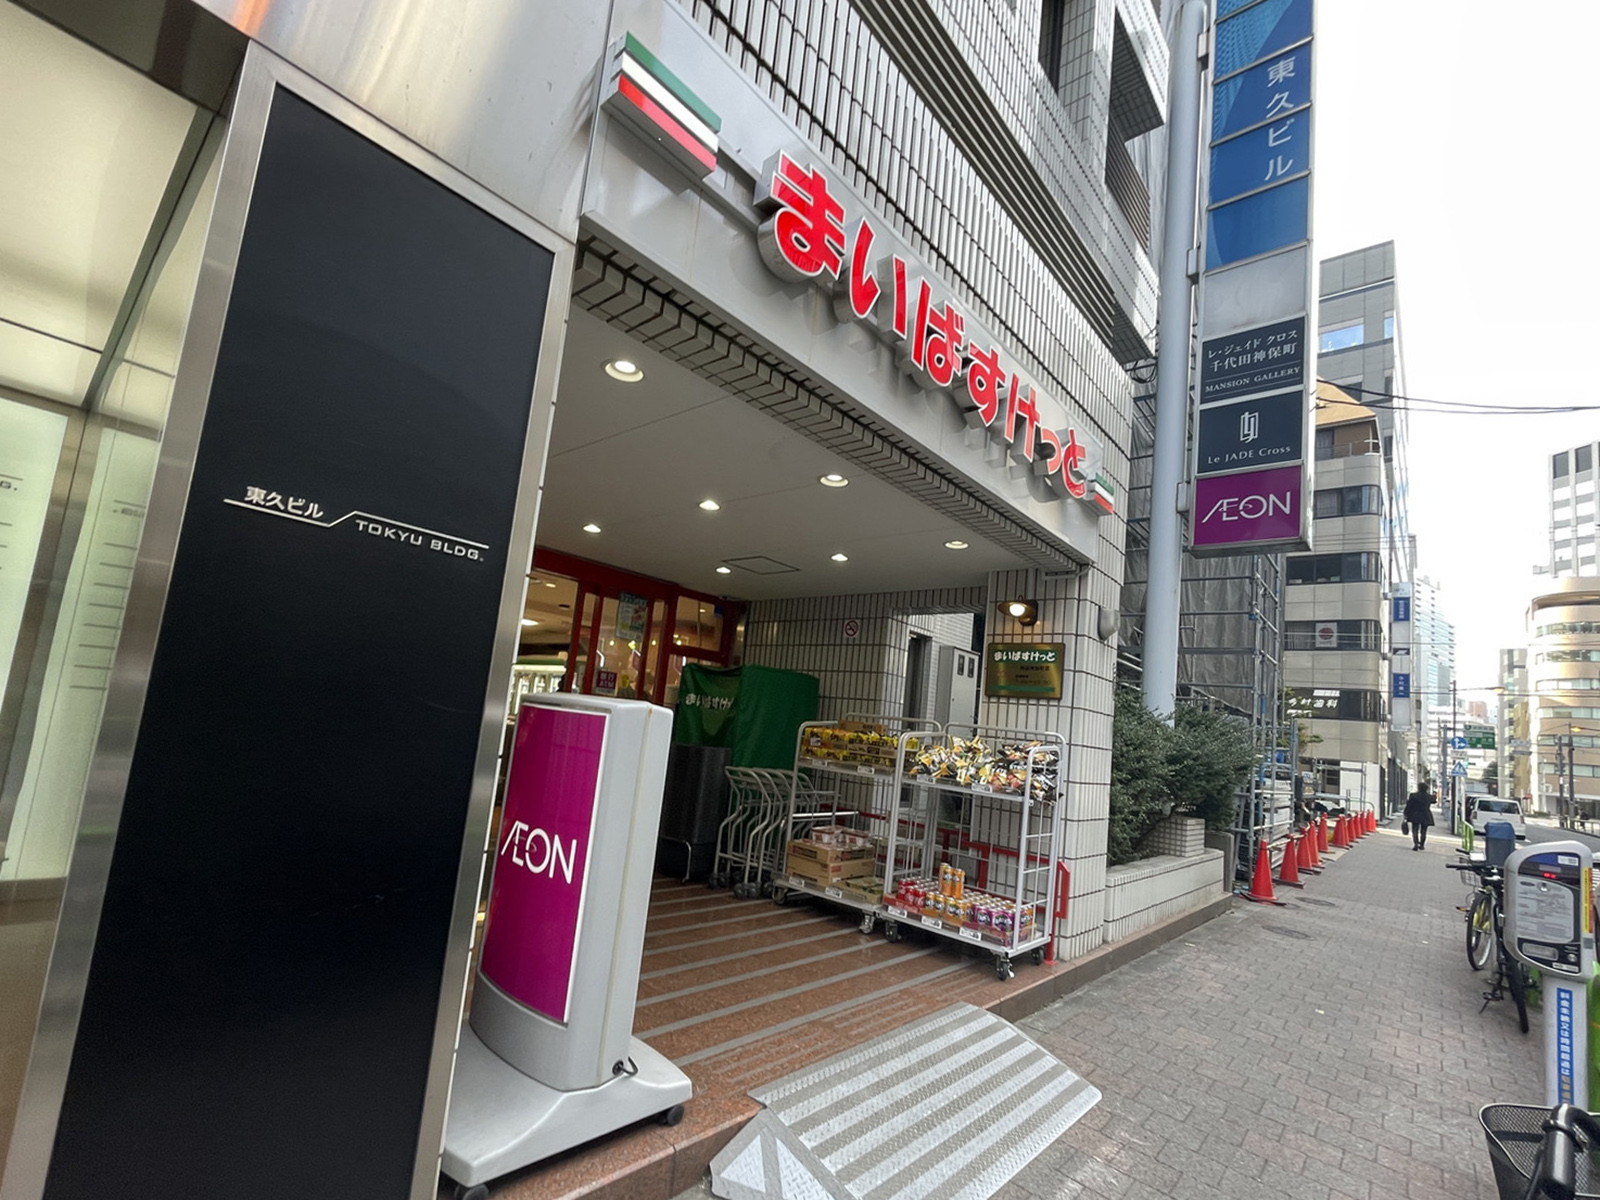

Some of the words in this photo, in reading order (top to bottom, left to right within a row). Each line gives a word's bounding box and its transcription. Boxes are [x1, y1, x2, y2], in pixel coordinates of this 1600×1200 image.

[1265, 56, 1296, 181] 東久ビル
[771, 149, 1088, 499] まいばすけっと
[1266, 330, 1298, 346] クロス
[1209, 342, 1298, 373] 千代田神保町
[1205, 377, 1250, 393] MANSION
[1254, 366, 1301, 383] GALLERY
[1208, 454, 1220, 465] Le
[1224, 449, 1254, 463] JADE
[1258, 445, 1291, 457] Cross
[243, 486, 325, 519] 東久ビル
[355, 519, 423, 546] TOKYU
[430, 539, 485, 562] BLDG.
[993, 650, 1056, 662] まいばすけっと
